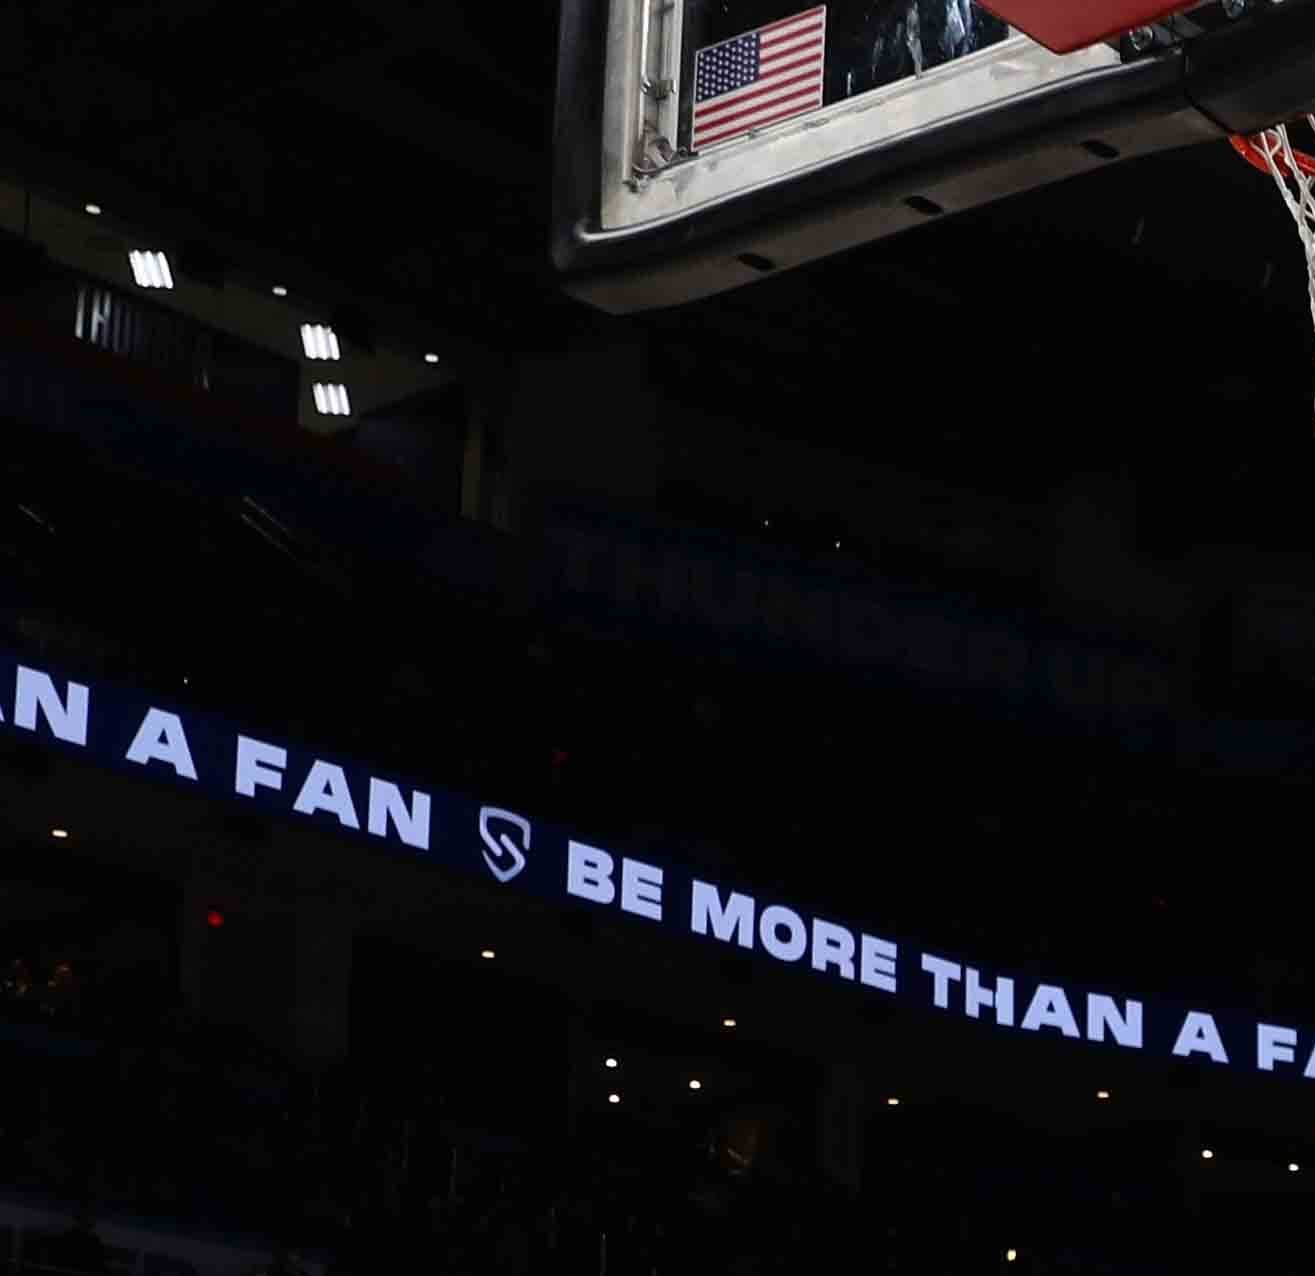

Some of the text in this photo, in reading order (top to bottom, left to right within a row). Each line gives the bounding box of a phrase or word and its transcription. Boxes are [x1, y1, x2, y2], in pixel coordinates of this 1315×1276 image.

[0, 664, 90, 747] N
[125, 706, 199, 781] A
[235, 735, 431, 851] FAN
[567, 839, 664, 921] BE
[691, 879, 898, 993] MORE
[921, 952, 1143, 1049] THAN
[1172, 1010, 1229, 1064] A
